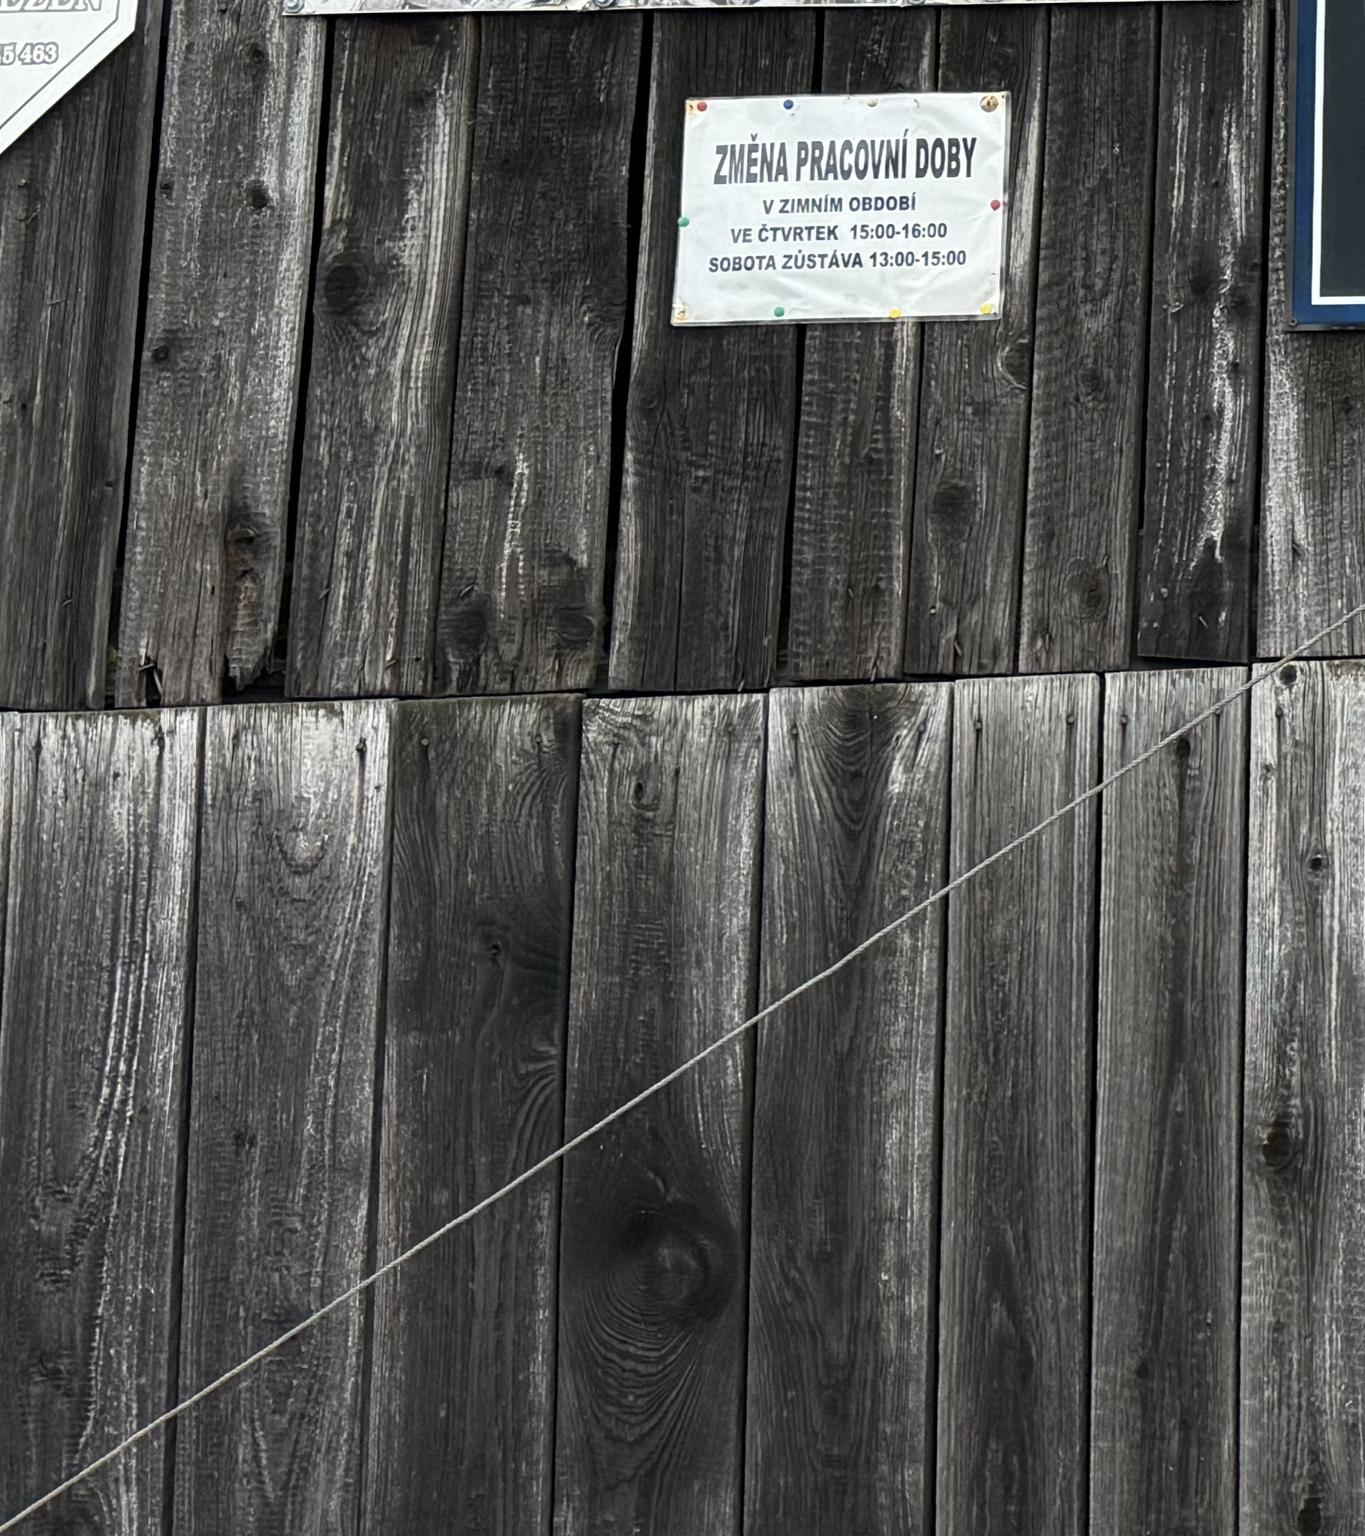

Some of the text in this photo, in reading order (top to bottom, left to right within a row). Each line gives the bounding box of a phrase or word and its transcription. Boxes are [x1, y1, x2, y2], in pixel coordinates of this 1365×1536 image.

[713, 129, 977, 185] ZMĚNA PRACOVNÍ DOBY
[763, 192, 917, 214] V ZIMNÍM OBDOBÍ
[731, 223, 948, 243] VE ČTVRTEK 15:00-16:00
[708, 248, 967, 272] SOBOTA ZŮSTÁVA 13:00-15:00
